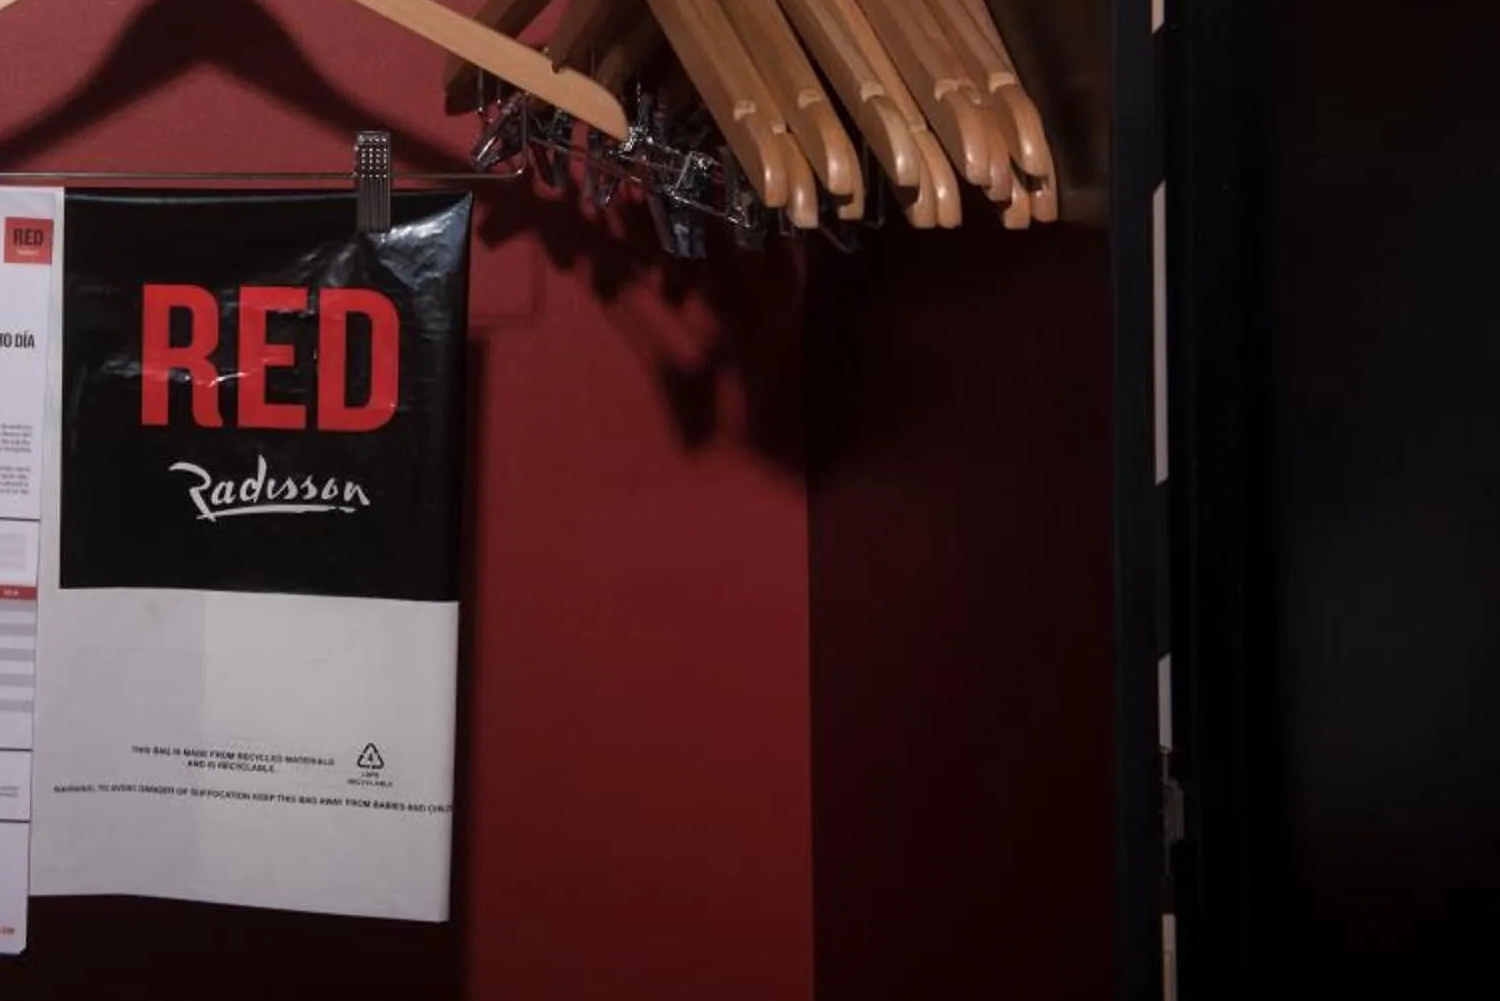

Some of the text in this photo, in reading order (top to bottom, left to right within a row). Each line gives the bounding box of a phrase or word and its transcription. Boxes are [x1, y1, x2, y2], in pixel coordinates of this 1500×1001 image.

[13, 228, 45, 247] RED
[14, 330, 35, 349] DÍA
[141, 282, 400, 433] RED
[168, 455, 371, 523] Radisson
[153, 746, 171, 756] BAG
[210, 750, 235, 760] FROM
[187, 760, 206, 769] AND
[138, 784, 175, 795] DANGER
[176, 786, 188, 795] OF
[190, 788, 250, 800] SUFFOCATION
[299, 795, 318, 805] BAG
[319, 796, 343, 807] AWAY
[346, 798, 371, 808] FROM
[407, 803, 427, 812] AND
